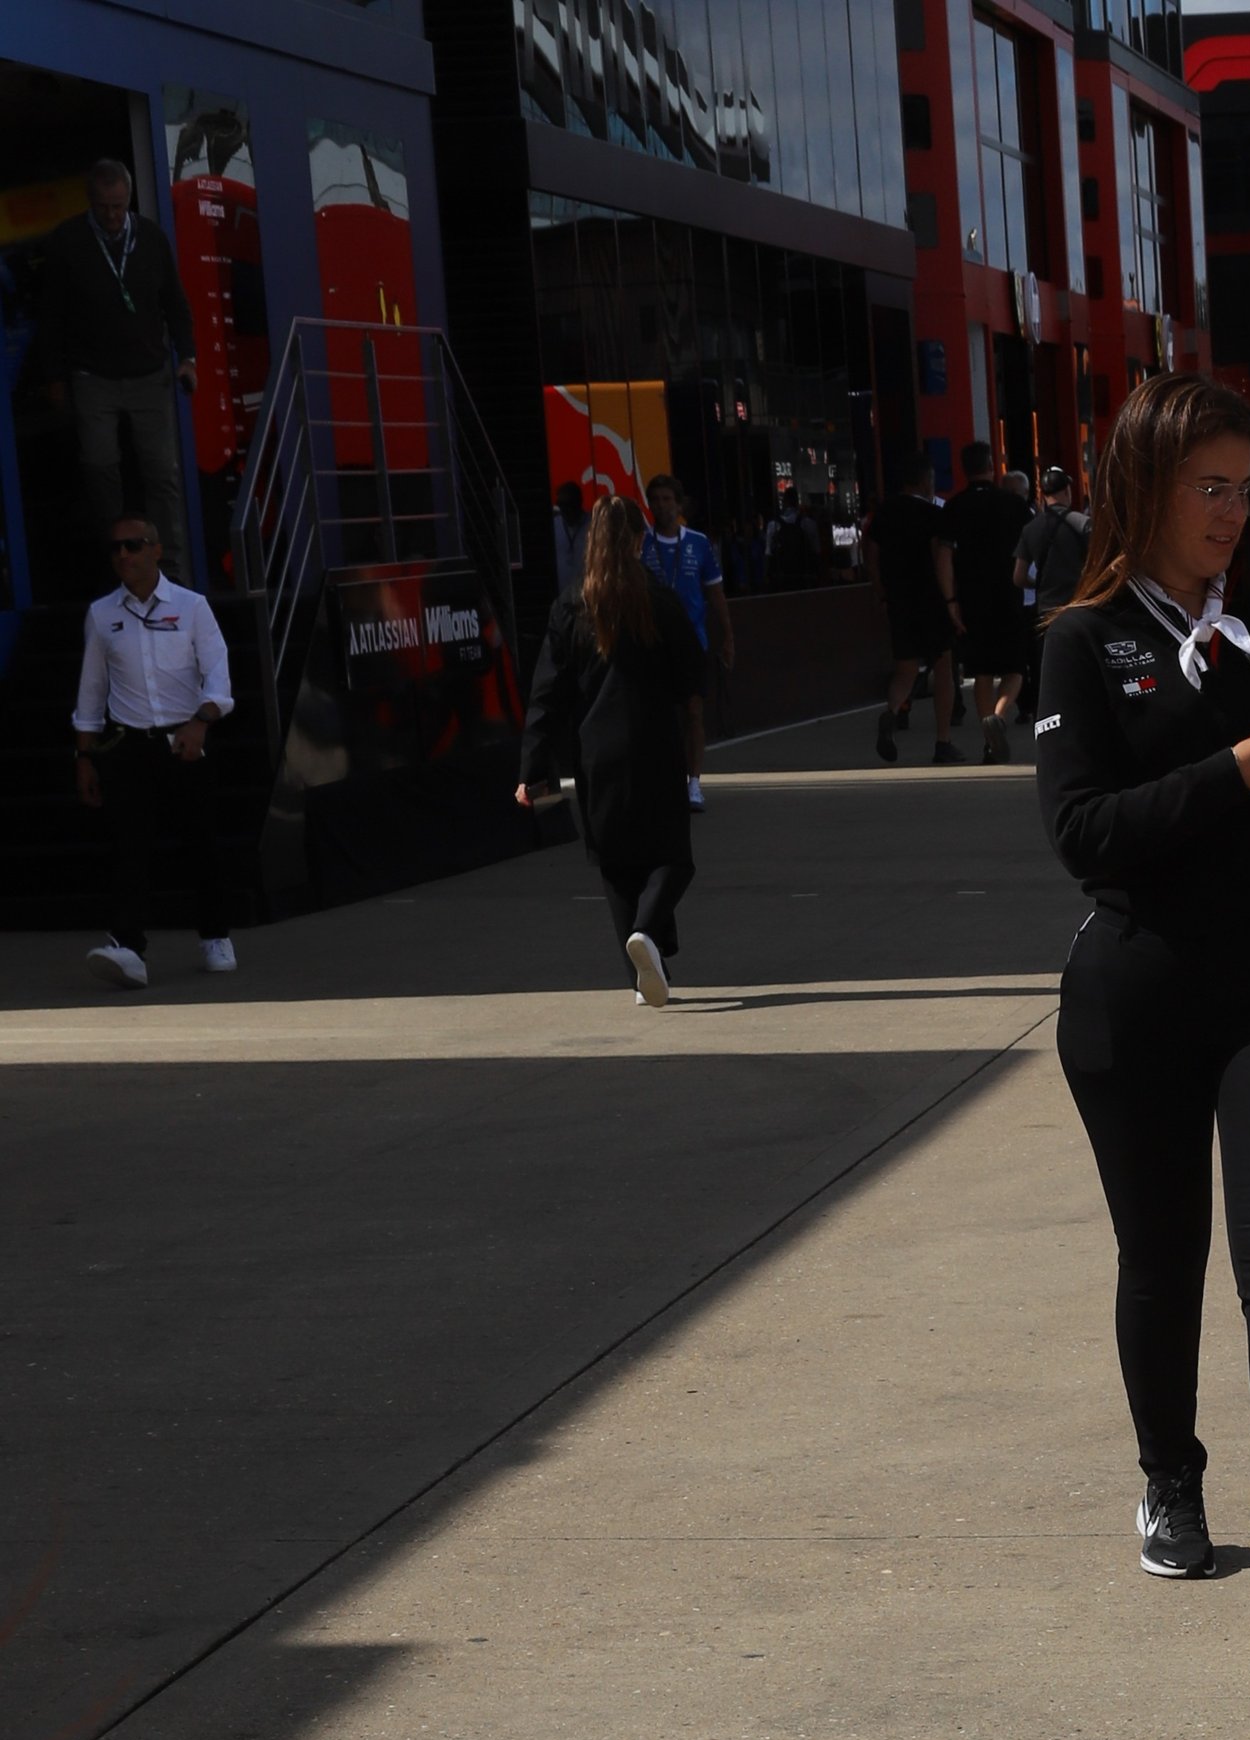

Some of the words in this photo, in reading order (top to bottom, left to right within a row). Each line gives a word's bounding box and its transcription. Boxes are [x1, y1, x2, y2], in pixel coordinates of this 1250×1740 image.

[359, 618, 419, 654] ATLASSIAN
[425, 605, 480, 644] Williams
[1104, 651, 1154, 665] CADILLAC
